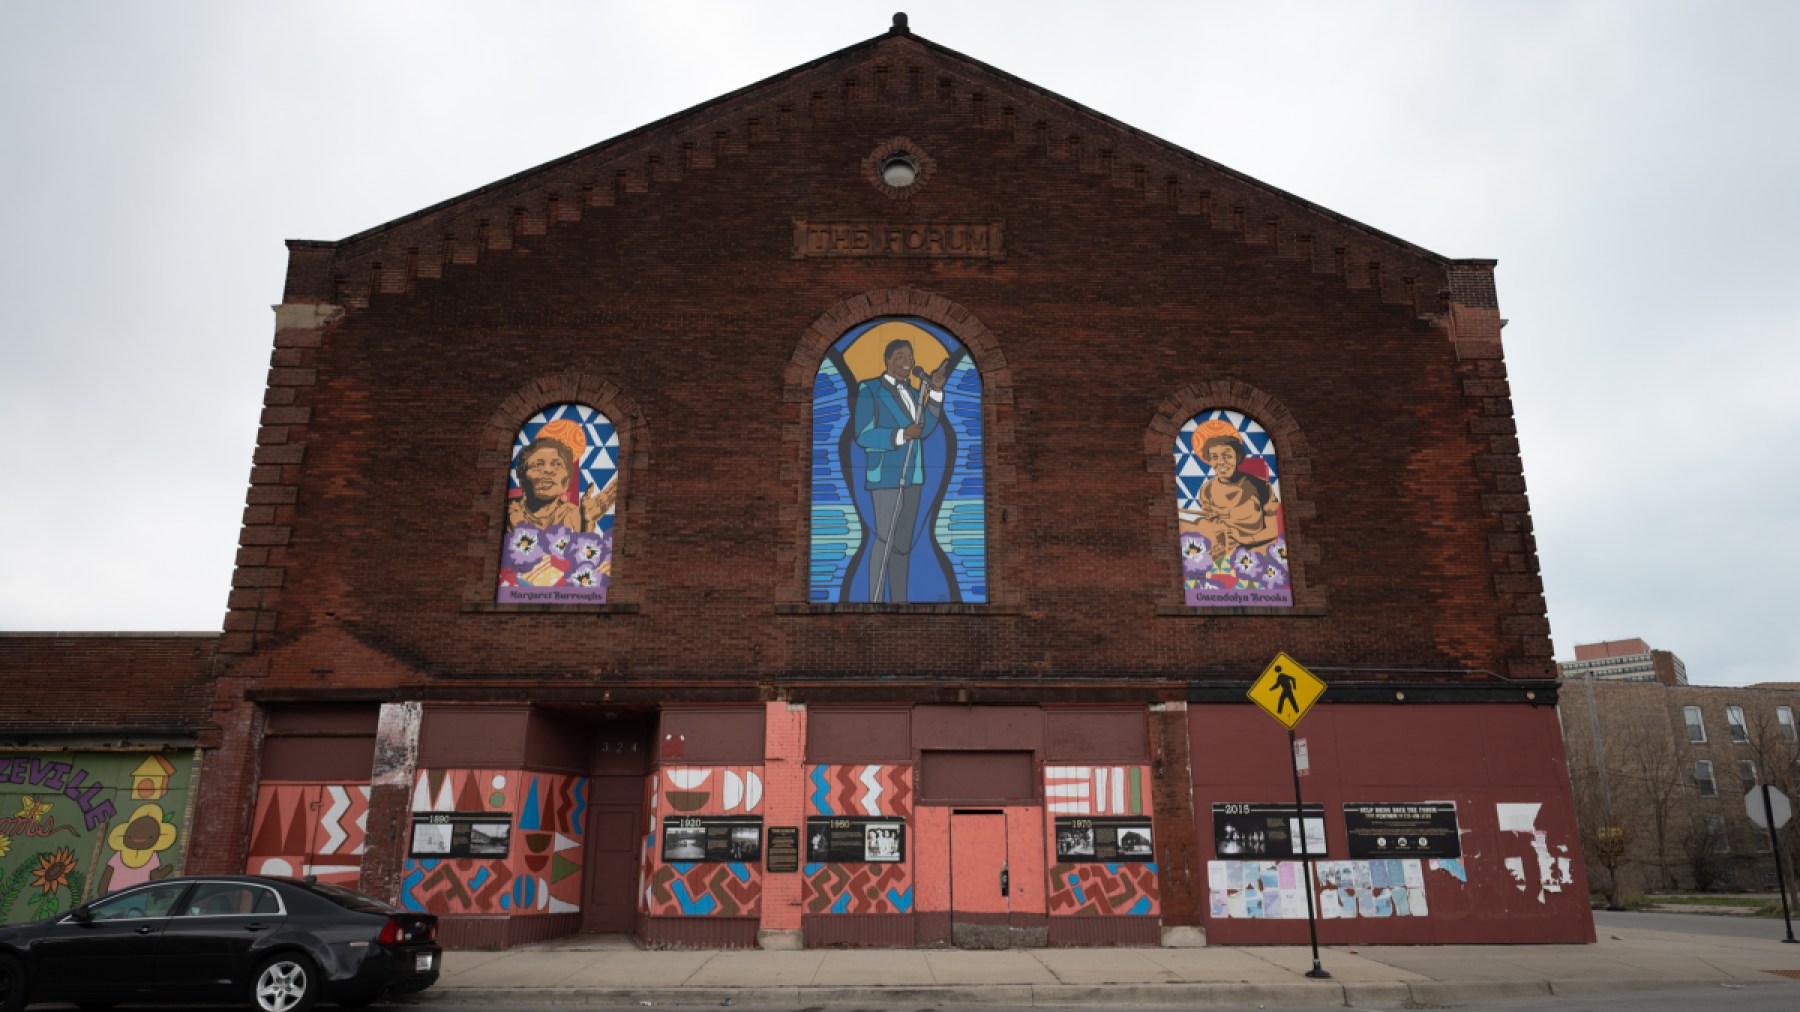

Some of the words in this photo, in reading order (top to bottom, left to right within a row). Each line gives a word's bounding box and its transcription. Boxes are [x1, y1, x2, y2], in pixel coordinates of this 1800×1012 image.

[808, 228, 870, 250] THE
[884, 228, 987, 252] FORUM
[509, 590, 552, 601] Margaret
[553, 590, 602, 602] Burroughs
[1196, 592, 1249, 604] Gwendolyn
[1250, 592, 1288, 603] Brooks
[1224, 804, 1250, 815] 2015
[679, 818, 702, 828] 1920
[1071, 819, 1093, 829] 1970
